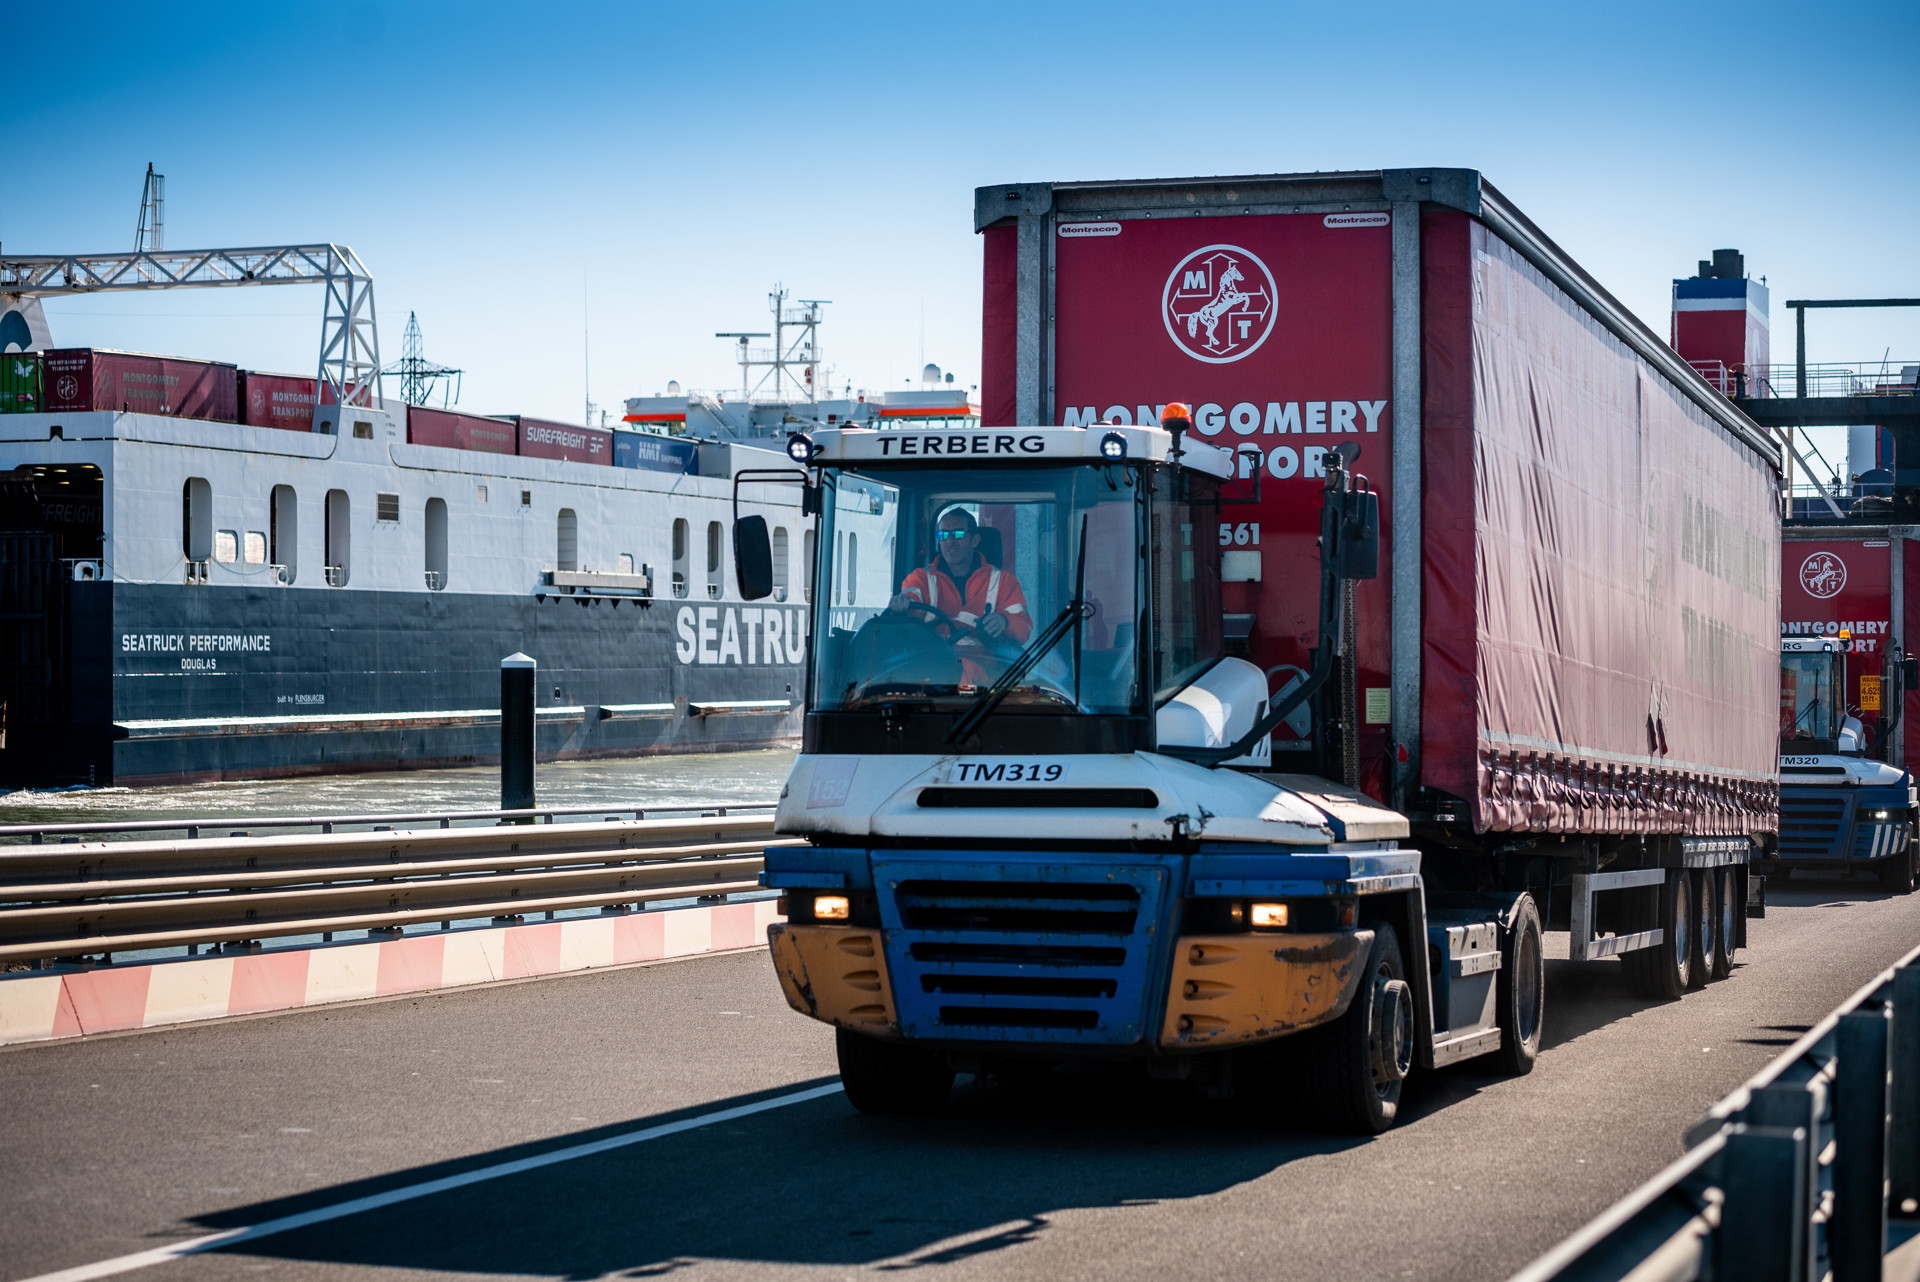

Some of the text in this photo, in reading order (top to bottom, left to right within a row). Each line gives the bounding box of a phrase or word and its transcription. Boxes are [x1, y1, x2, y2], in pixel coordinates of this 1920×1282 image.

[1061, 226, 1119, 234] Montracon
[1183, 270, 1207, 290] M
[1237, 320, 1252, 339] T
[122, 371, 180, 386] MONTGOMERY
[122, 387, 171, 401] TRANSPORT
[272, 391, 317, 405] MONTGOME
[526, 426, 587, 450] SUREFREIGHT
[877, 435, 1045, 455] TERBERG
[1219, 522, 1260, 546] 561
[676, 606, 811, 666] SEATRU
[1781, 620, 1889, 634] ONTGOMERY
[122, 634, 271, 652] SEATRUCK PERFORMANCE
[181, 658, 217, 670] DOUGLAS
[956, 763, 1064, 783] TM319
